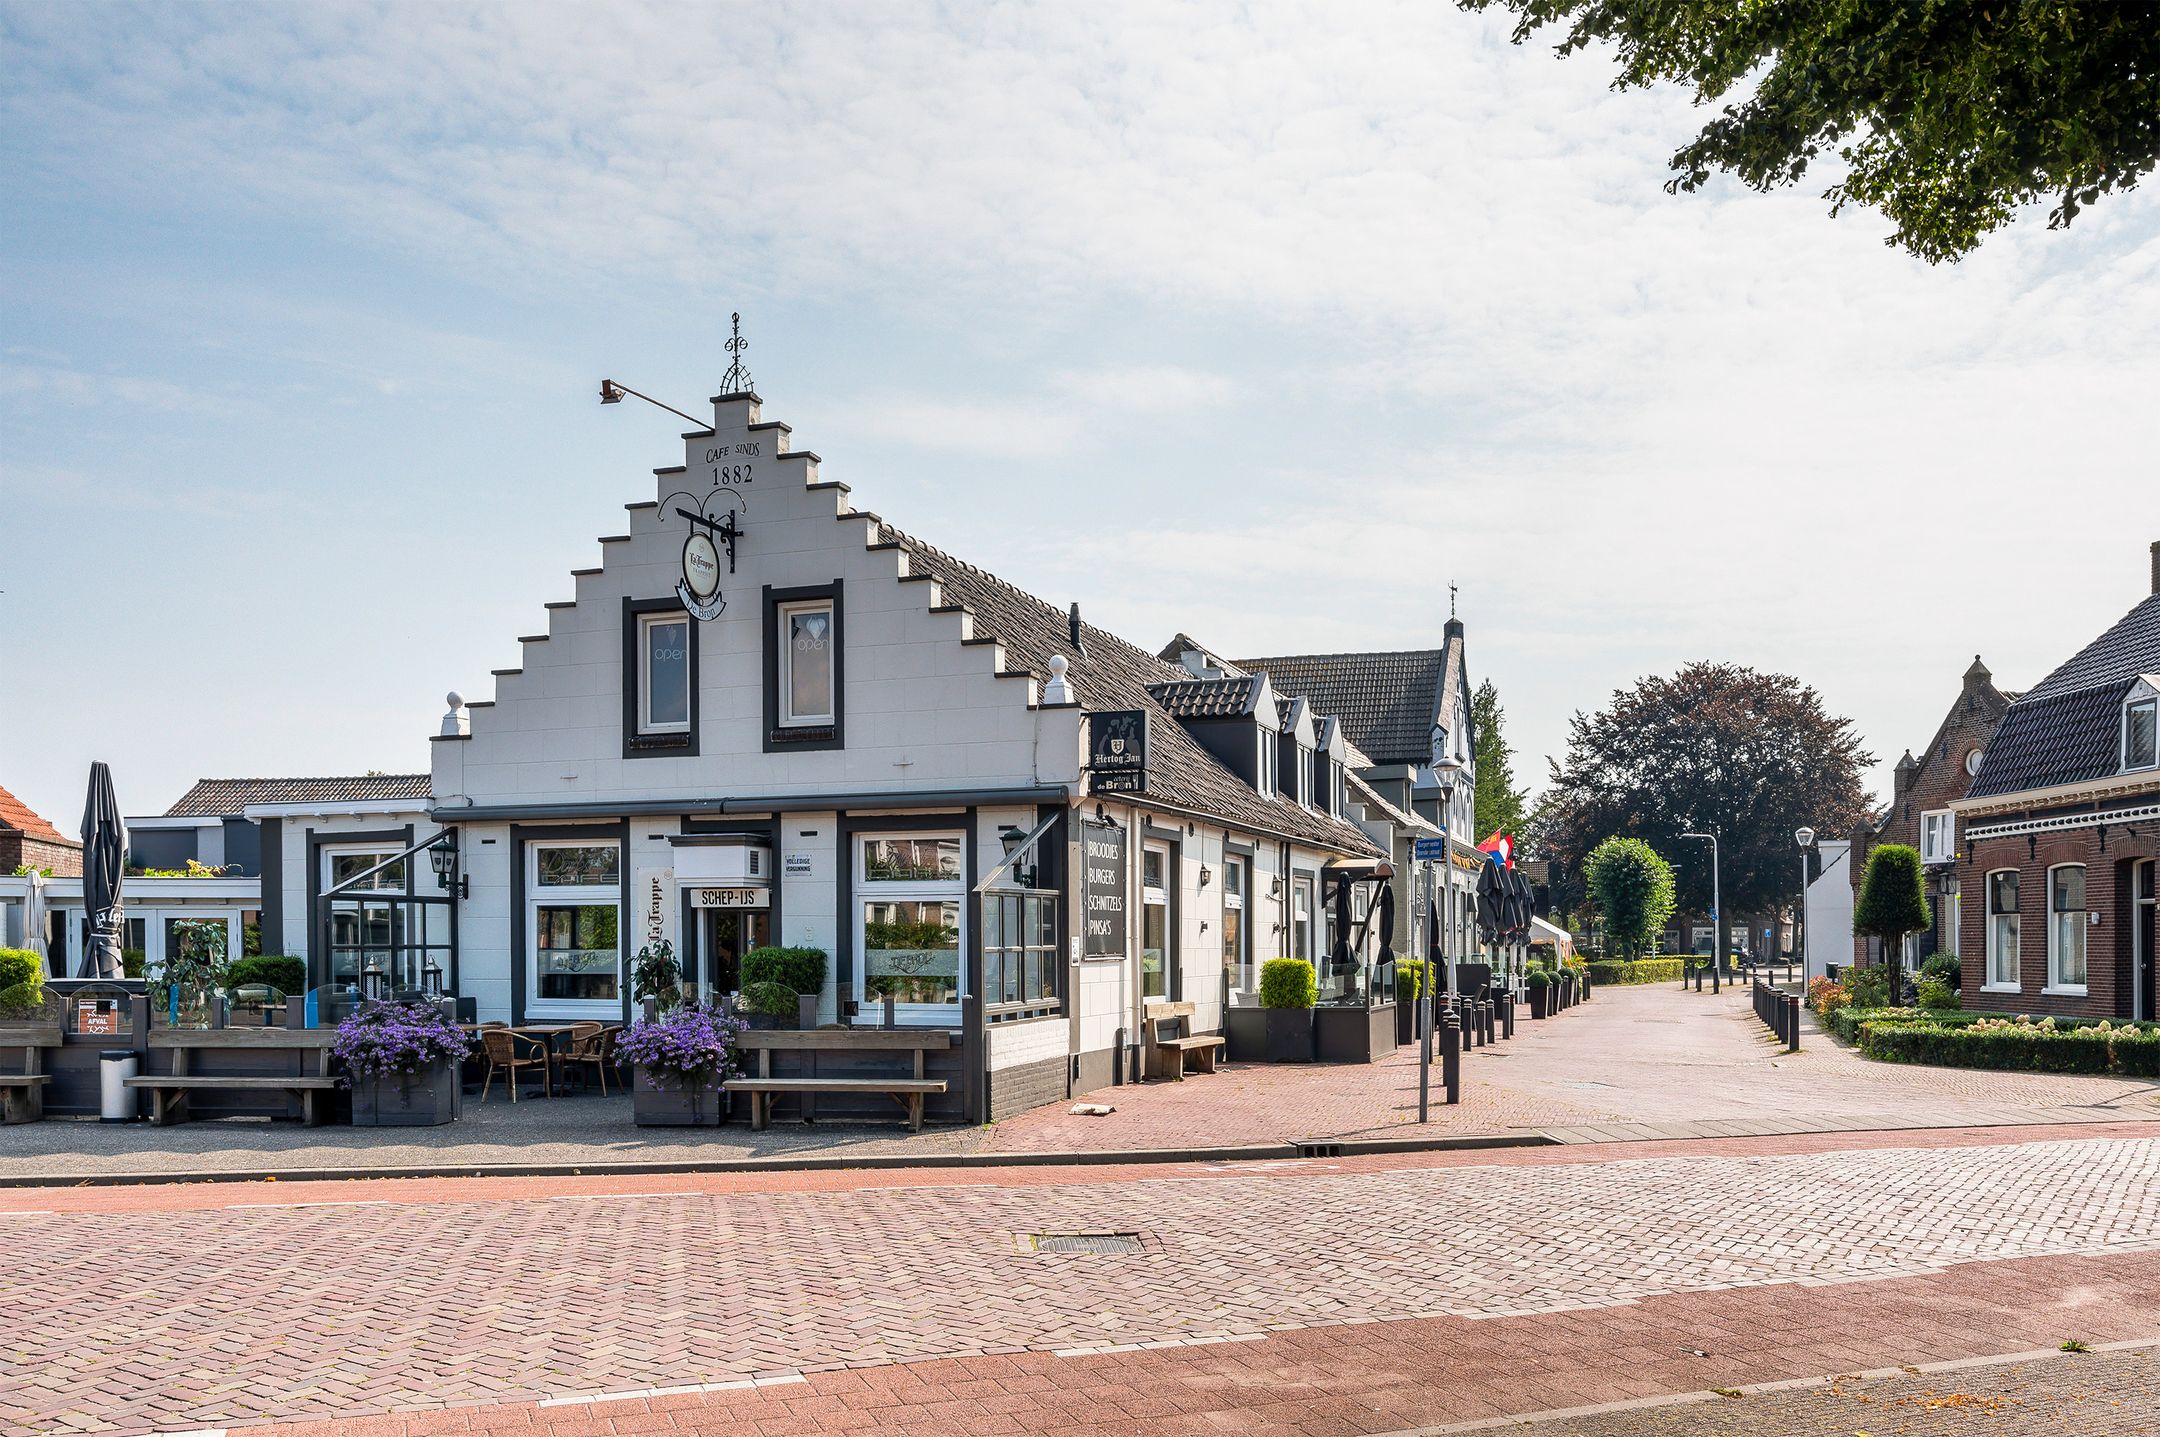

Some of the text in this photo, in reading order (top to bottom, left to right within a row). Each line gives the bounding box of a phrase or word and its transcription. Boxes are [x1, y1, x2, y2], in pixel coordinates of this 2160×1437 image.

[705, 442, 759, 463] CAFE SINDS
[712, 464, 753, 485] 1882
[696, 555, 714, 571] Trappe
[686, 598, 716, 619] De Bron
[1094, 752, 1141, 766] Hertog Jan
[1105, 780, 1132, 790] Bron
[1089, 841, 1119, 860] BROODJES
[1089, 867, 1116, 885] BURGERS
[647, 877, 665, 927] Trappe
[702, 890, 755, 905] SCHEP-IJS
[1089, 894, 1123, 912] SCHNITZELS
[1089, 919, 1112, 937] PINSA'S
